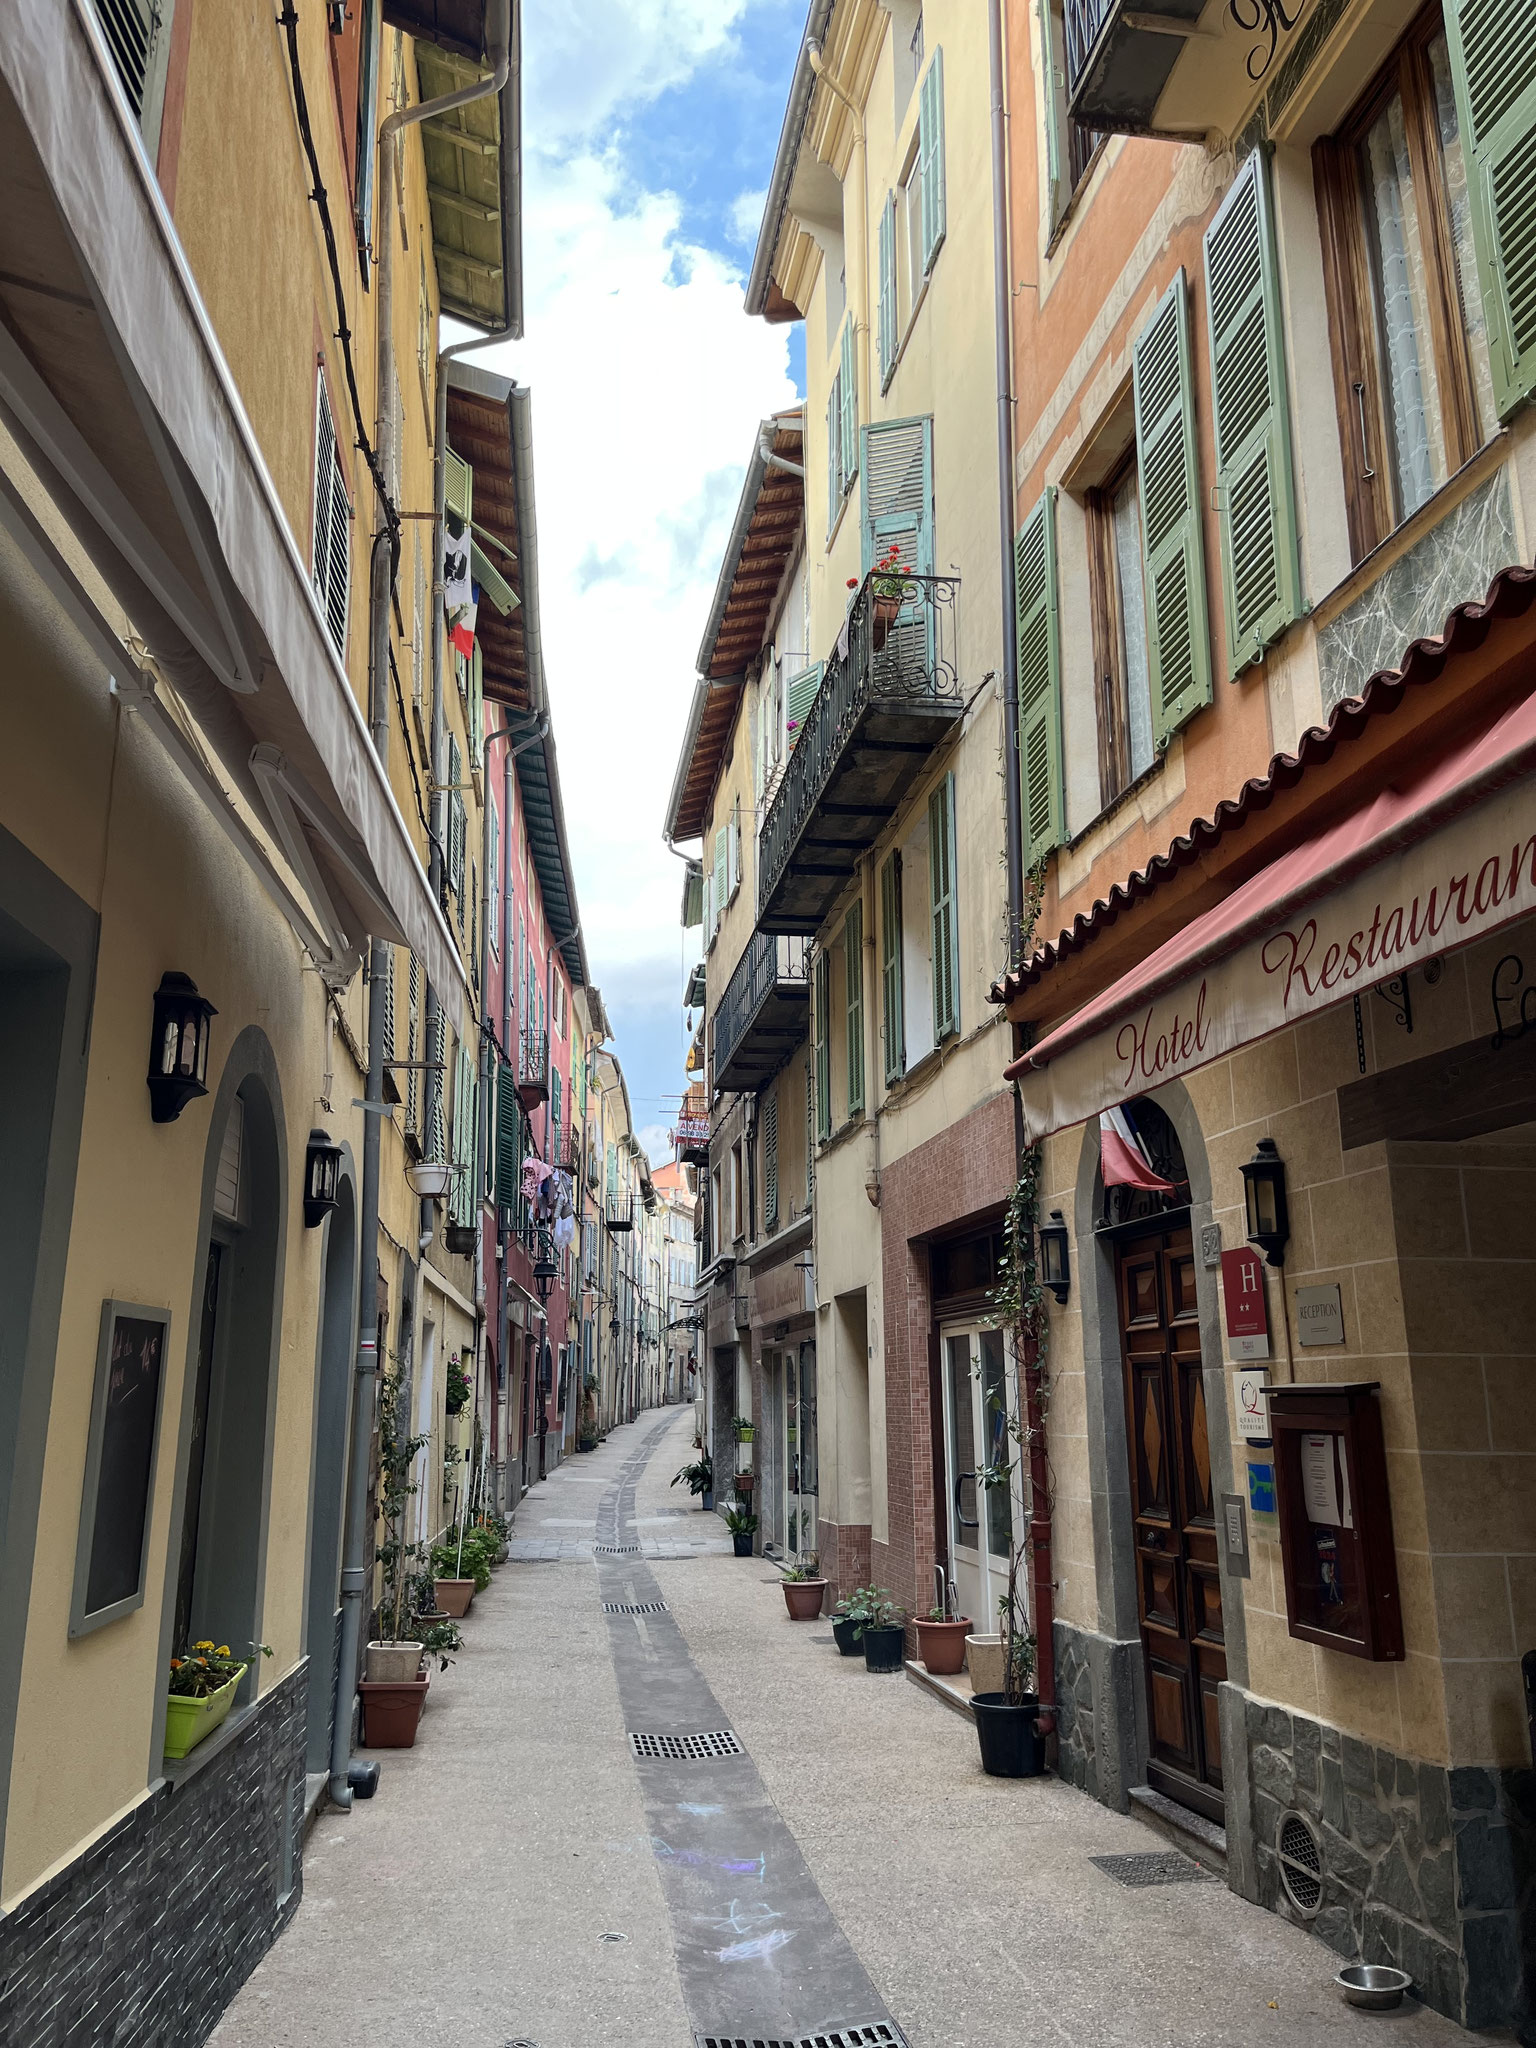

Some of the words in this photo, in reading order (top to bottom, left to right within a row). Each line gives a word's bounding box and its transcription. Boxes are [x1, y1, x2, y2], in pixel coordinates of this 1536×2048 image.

[1116, 978, 1212, 1087] Hotel
[1240, 1262, 1258, 1293] H
[1299, 1303, 1339, 1320] RECEPTION
